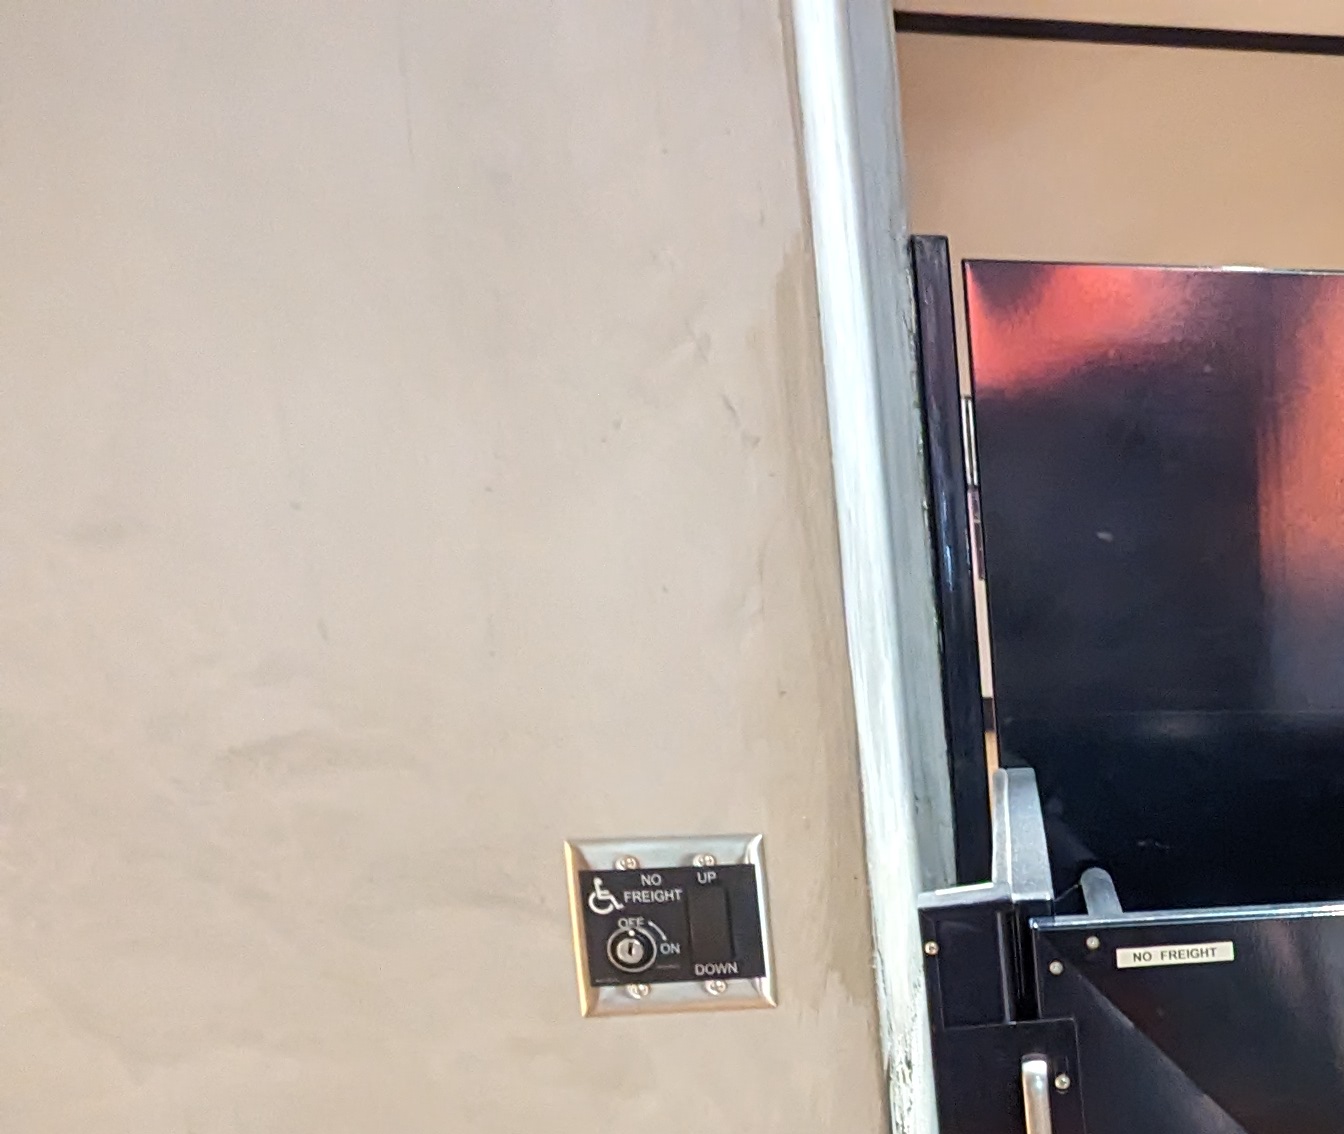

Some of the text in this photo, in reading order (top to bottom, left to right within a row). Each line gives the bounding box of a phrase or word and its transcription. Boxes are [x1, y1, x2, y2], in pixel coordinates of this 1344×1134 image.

[640, 873, 662, 886] NO
[697, 871, 717, 884] UP
[624, 889, 683, 903] FREIGHT
[617, 917, 645, 929] OFF
[660, 943, 681, 954] ON
[1133, 947, 1217, 962] NO FREIGHT
[694, 962, 738, 976] DOWN
